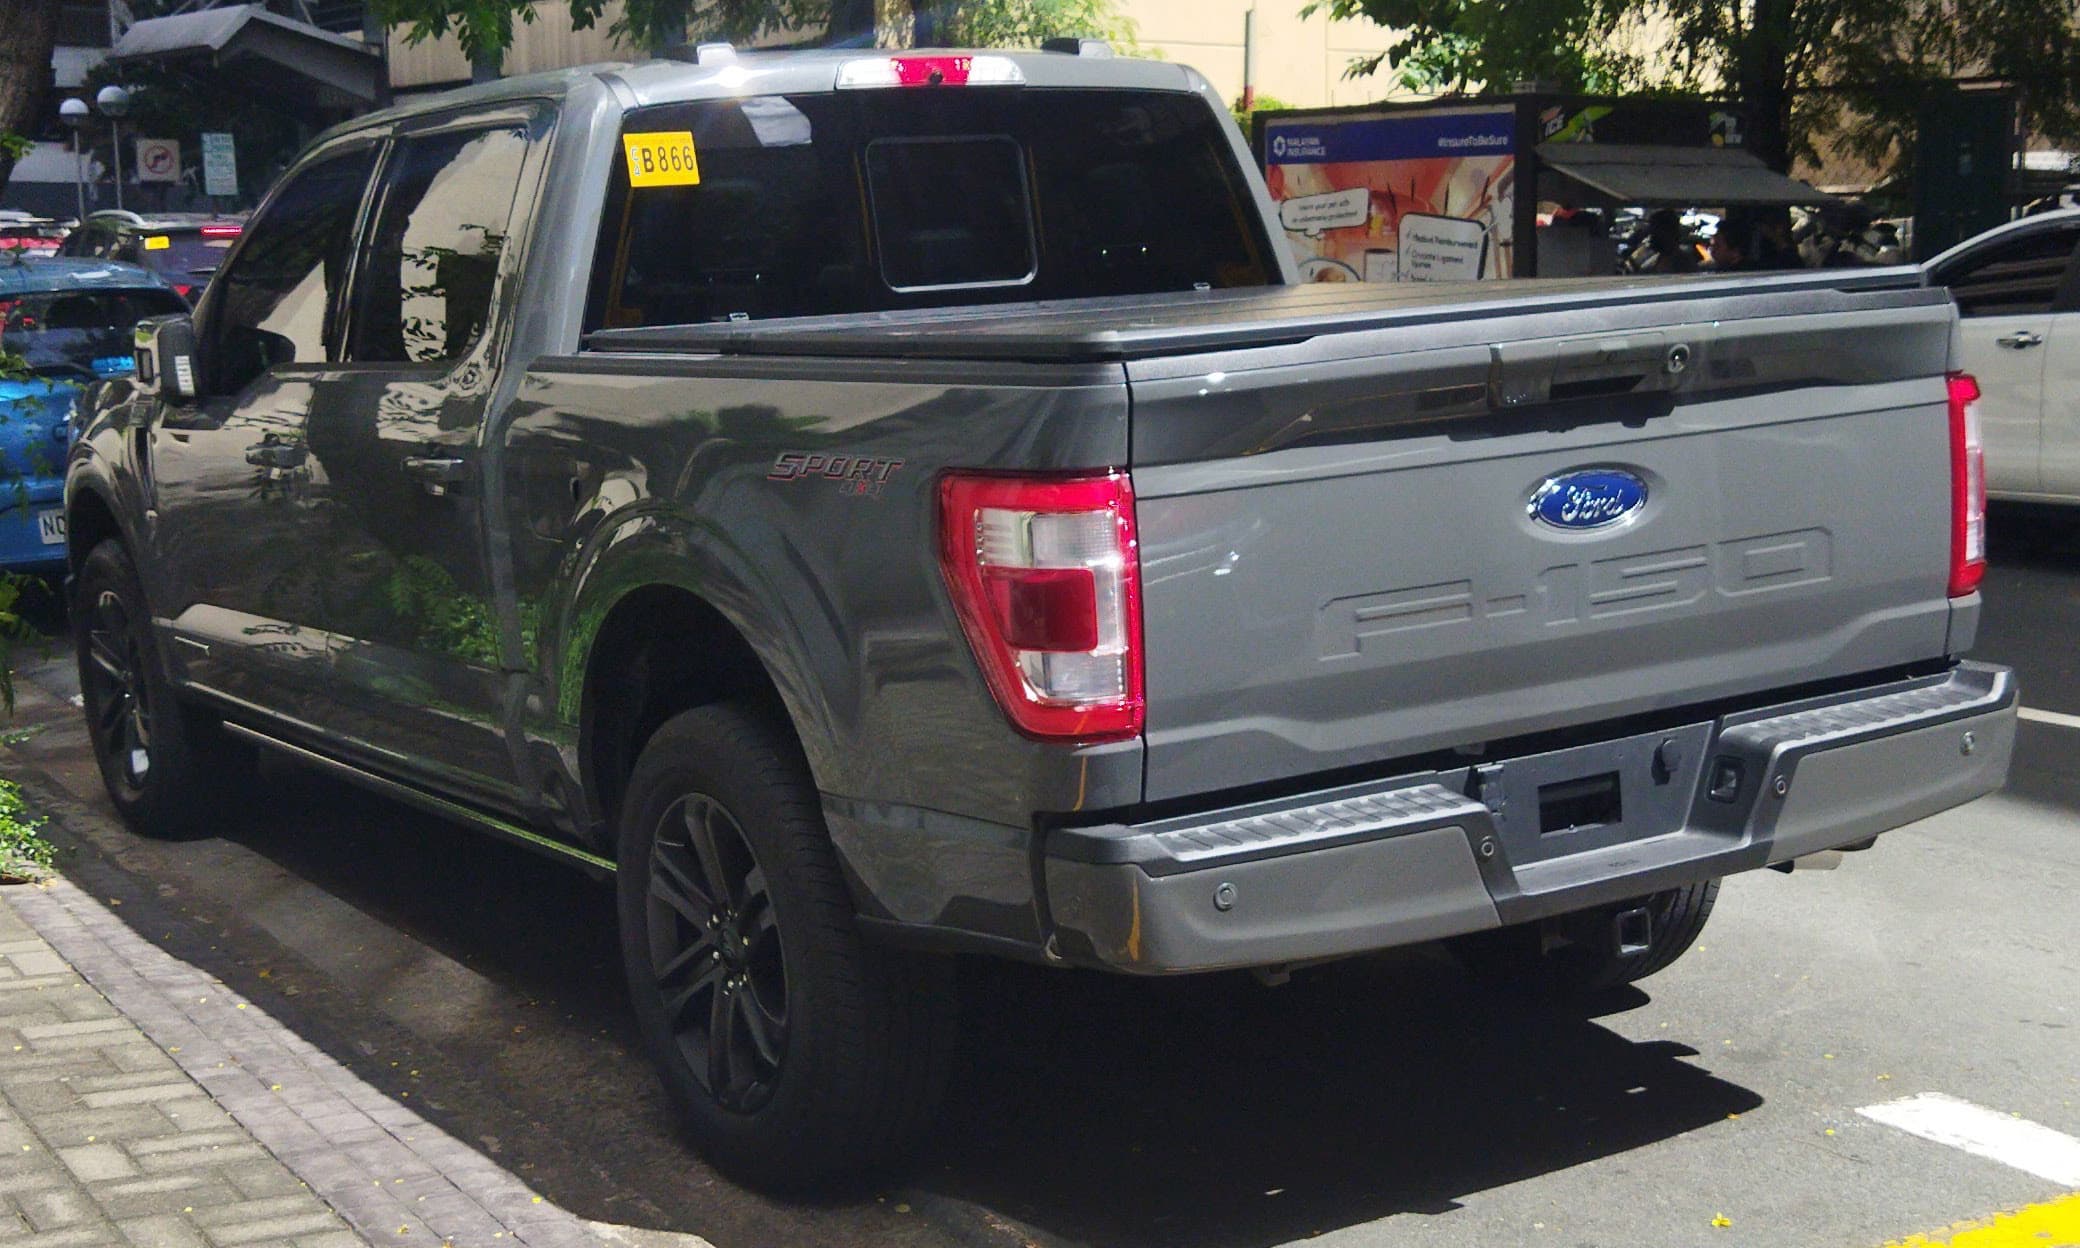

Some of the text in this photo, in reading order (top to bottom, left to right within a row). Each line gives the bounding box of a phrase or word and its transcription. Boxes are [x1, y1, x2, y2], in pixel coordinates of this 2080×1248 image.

[1287, 137, 1320, 146] MALAYAN
[1287, 146, 1327, 156] INSURANCE
[767, 452, 905, 483] SPORT
[1561, 484, 1625, 522] Ford
[1315, 526, 1832, 662] F-150
